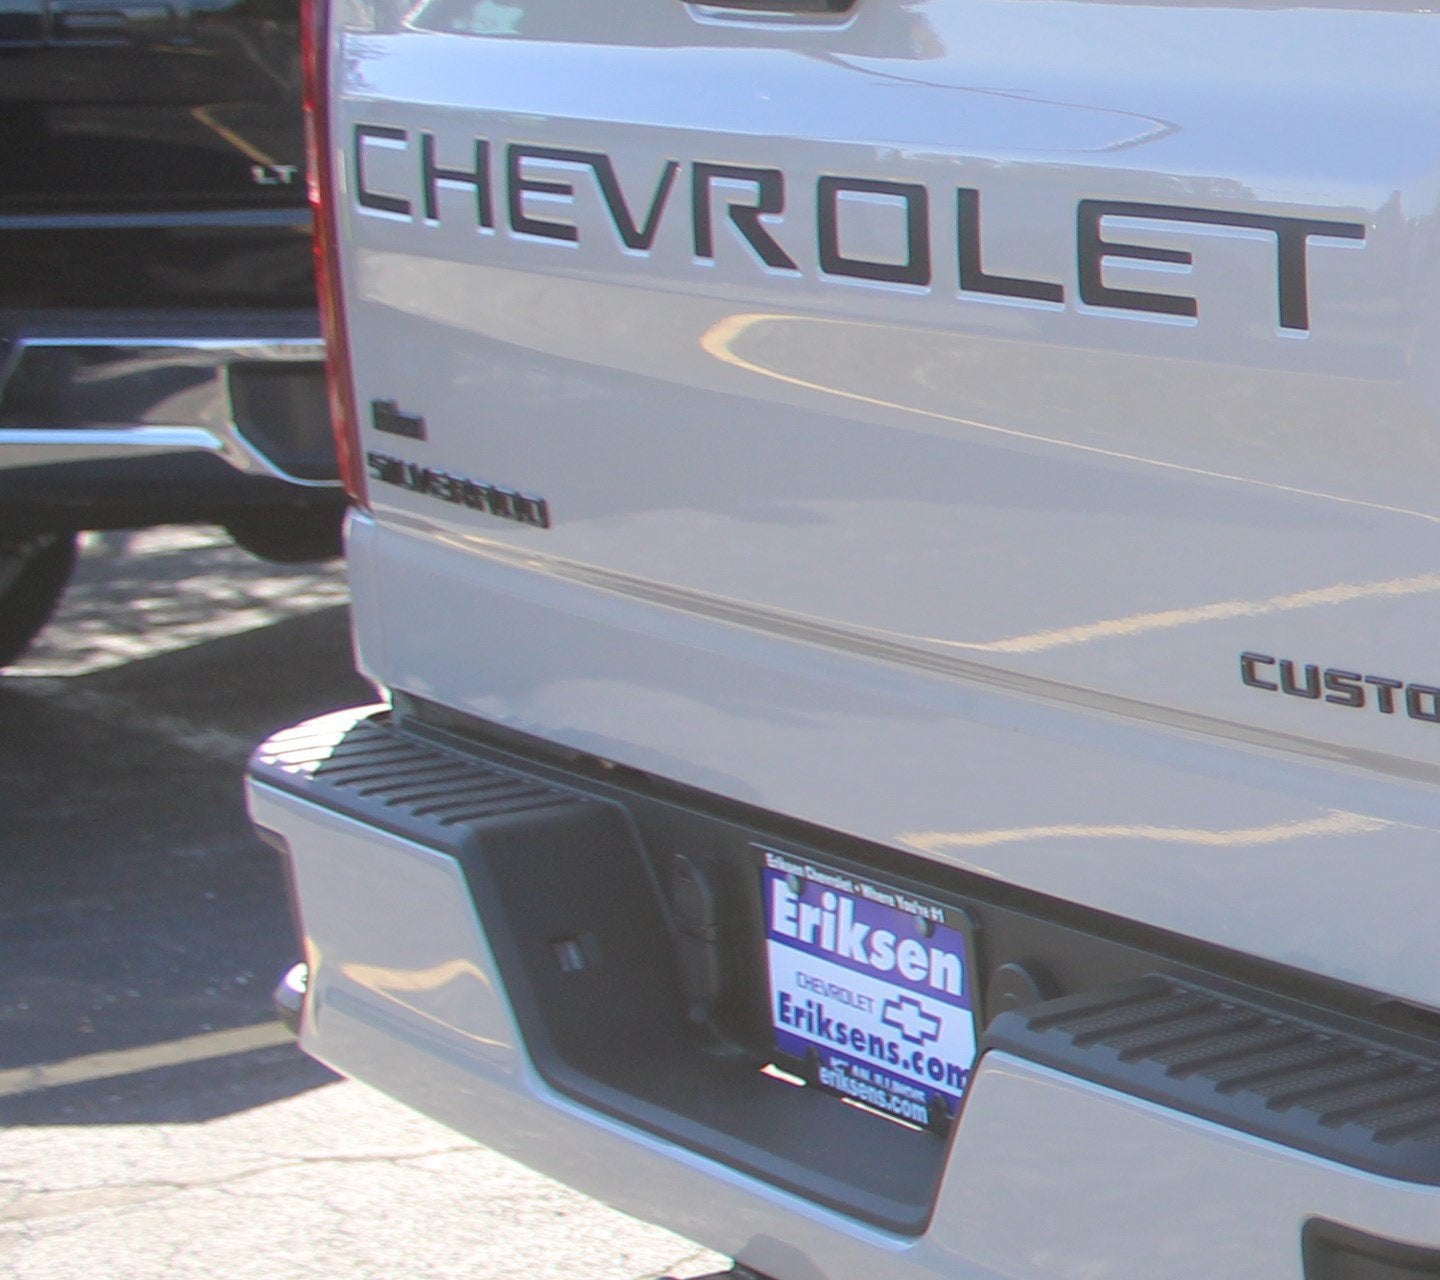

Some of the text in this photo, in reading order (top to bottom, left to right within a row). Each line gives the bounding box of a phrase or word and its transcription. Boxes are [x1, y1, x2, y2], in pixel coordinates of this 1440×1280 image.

[252, 164, 298, 185] LT
[353, 125, 1366, 332] CHEVROLET
[772, 877, 964, 997] Eriksen
[797, 971, 875, 1013] CHEVROLET
[778, 990, 970, 1088] Eriksens.com
[819, 1065, 929, 1124] eriksens.com
